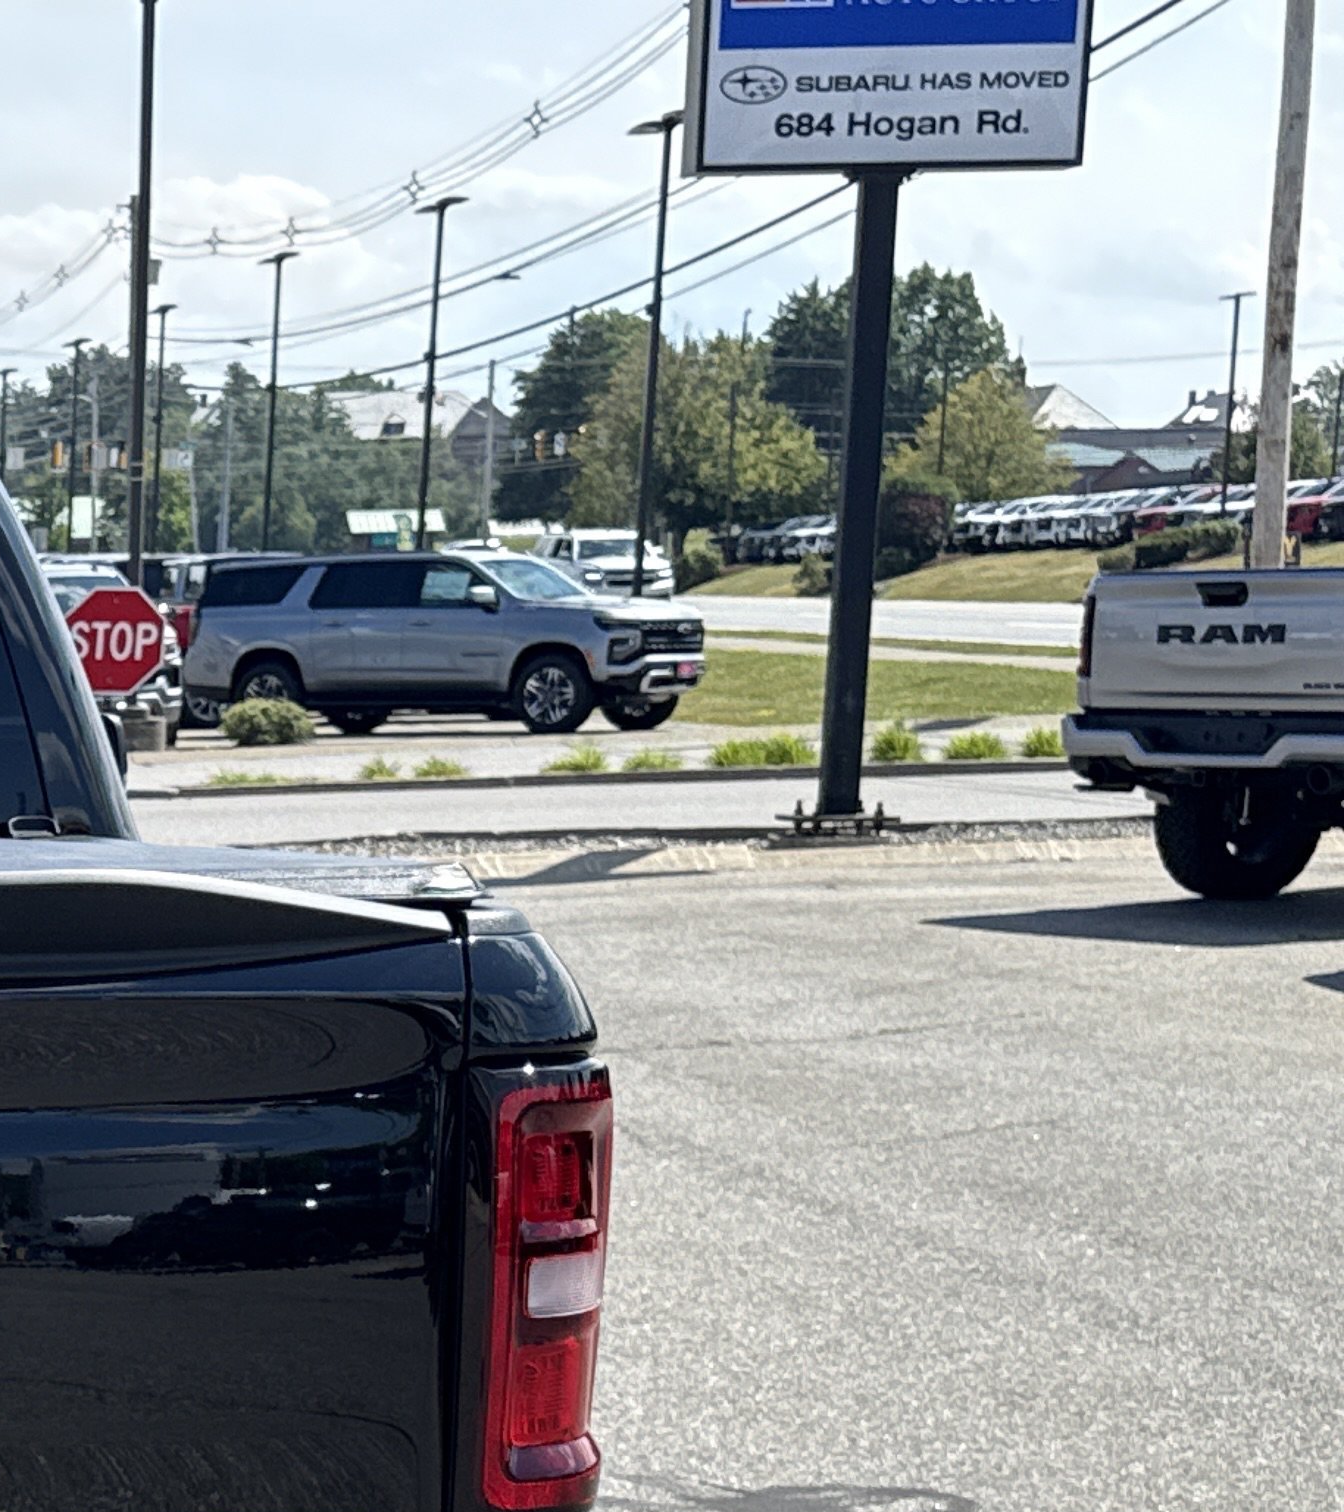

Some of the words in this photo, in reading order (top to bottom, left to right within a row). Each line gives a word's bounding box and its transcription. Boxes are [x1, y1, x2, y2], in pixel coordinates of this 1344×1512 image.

[795, 74, 910, 93] SUBARU
[922, 73, 971, 91] HAS
[979, 71, 1070, 90] MOVED
[774, 113, 834, 138] 684
[848, 111, 959, 140] Hogan
[976, 109, 1030, 136] Rd.
[72, 621, 158, 661] STOP
[1157, 624, 1286, 644] RAM
